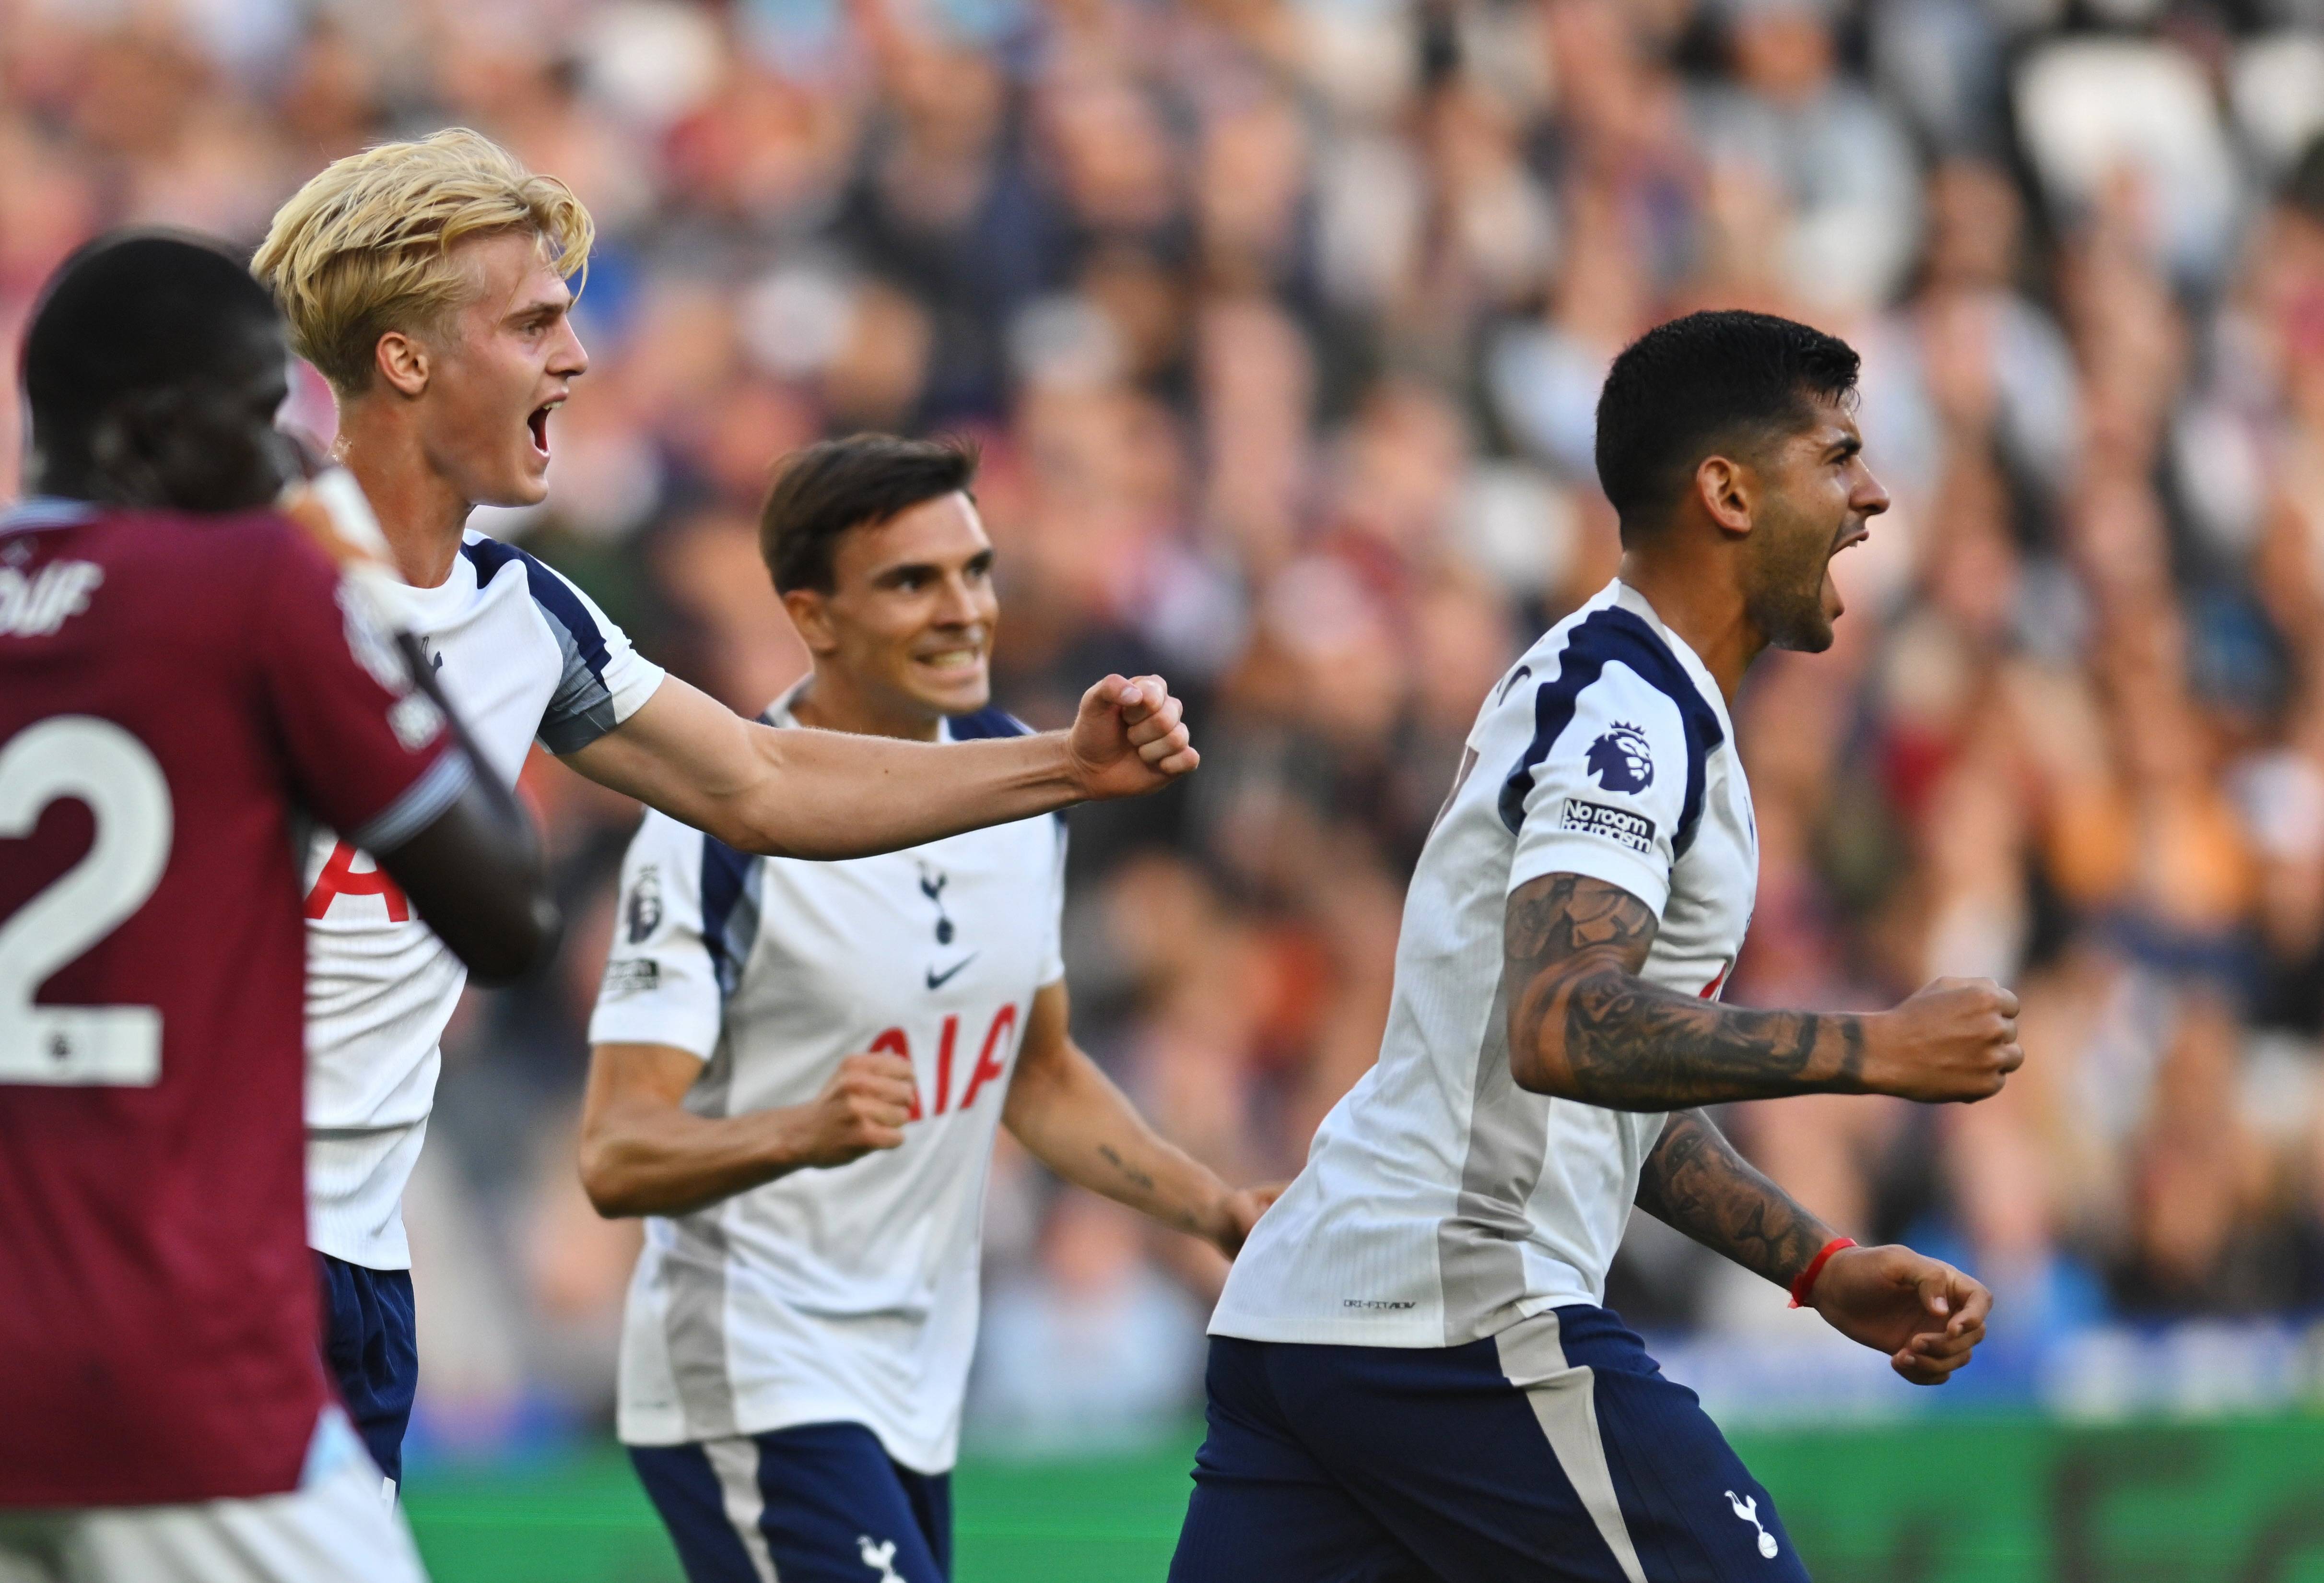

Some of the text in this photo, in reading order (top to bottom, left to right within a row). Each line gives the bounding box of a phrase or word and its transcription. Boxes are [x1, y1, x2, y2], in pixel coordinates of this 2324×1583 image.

[1561, 815, 1589, 831] for
[1563, 798, 1647, 836] No room
